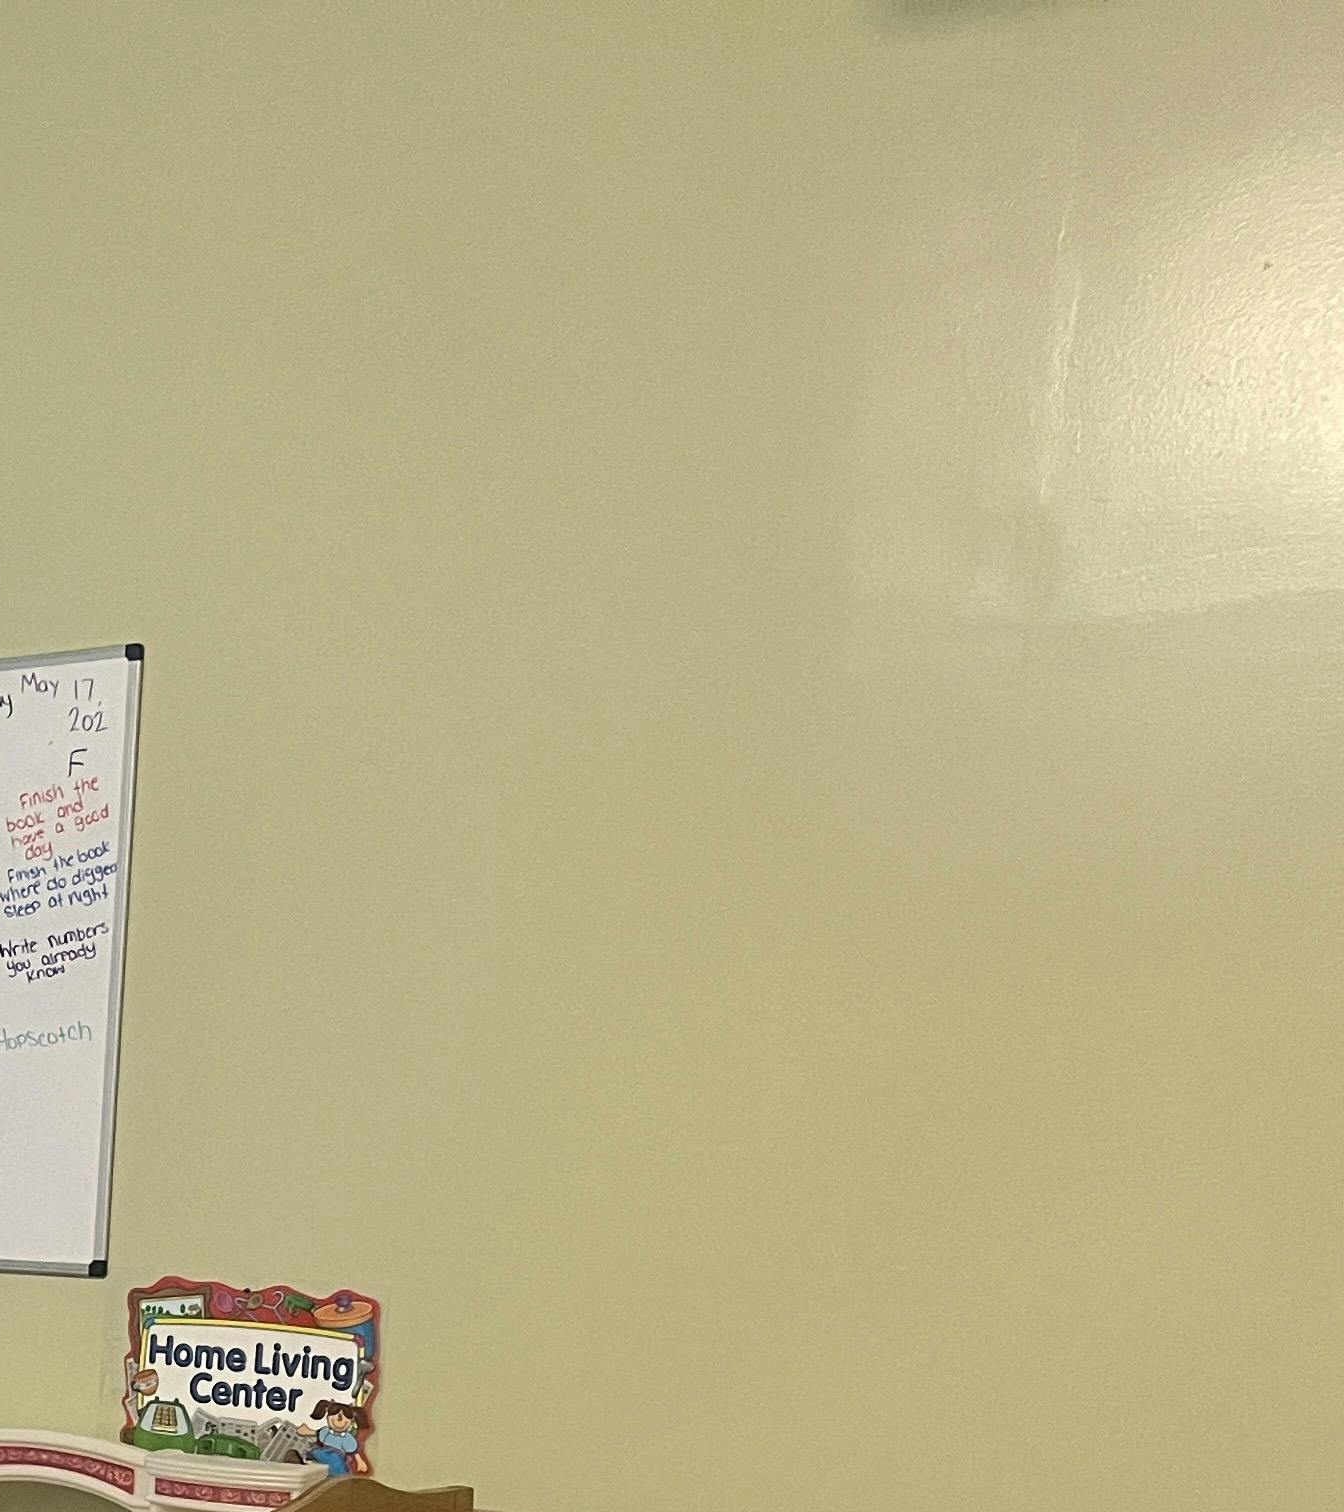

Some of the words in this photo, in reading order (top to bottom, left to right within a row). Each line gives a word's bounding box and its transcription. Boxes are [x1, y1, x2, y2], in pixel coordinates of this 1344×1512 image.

[21, 673, 59, 697] May
[68, 748, 87, 777] F
[20, 784, 64, 809] Finish
[73, 777, 99, 795] the
[6, 812, 45, 832] book
[57, 791, 83, 818] and
[56, 822, 64, 833] a
[75, 803, 109, 832] good
[26, 842, 52, 861] day
[54, 856, 74, 871] the
[77, 841, 110, 862] book
[47, 877, 66, 890] do
[49, 893, 63, 908] at
[0, 939, 37, 957] Write
[48, 922, 109, 947] numbers
[7, 959, 31, 977] you
[41, 942, 96, 965] already
[149, 1334, 246, 1372] Home
[254, 1342, 354, 1391] Living
[189, 1372, 303, 1412] Center
